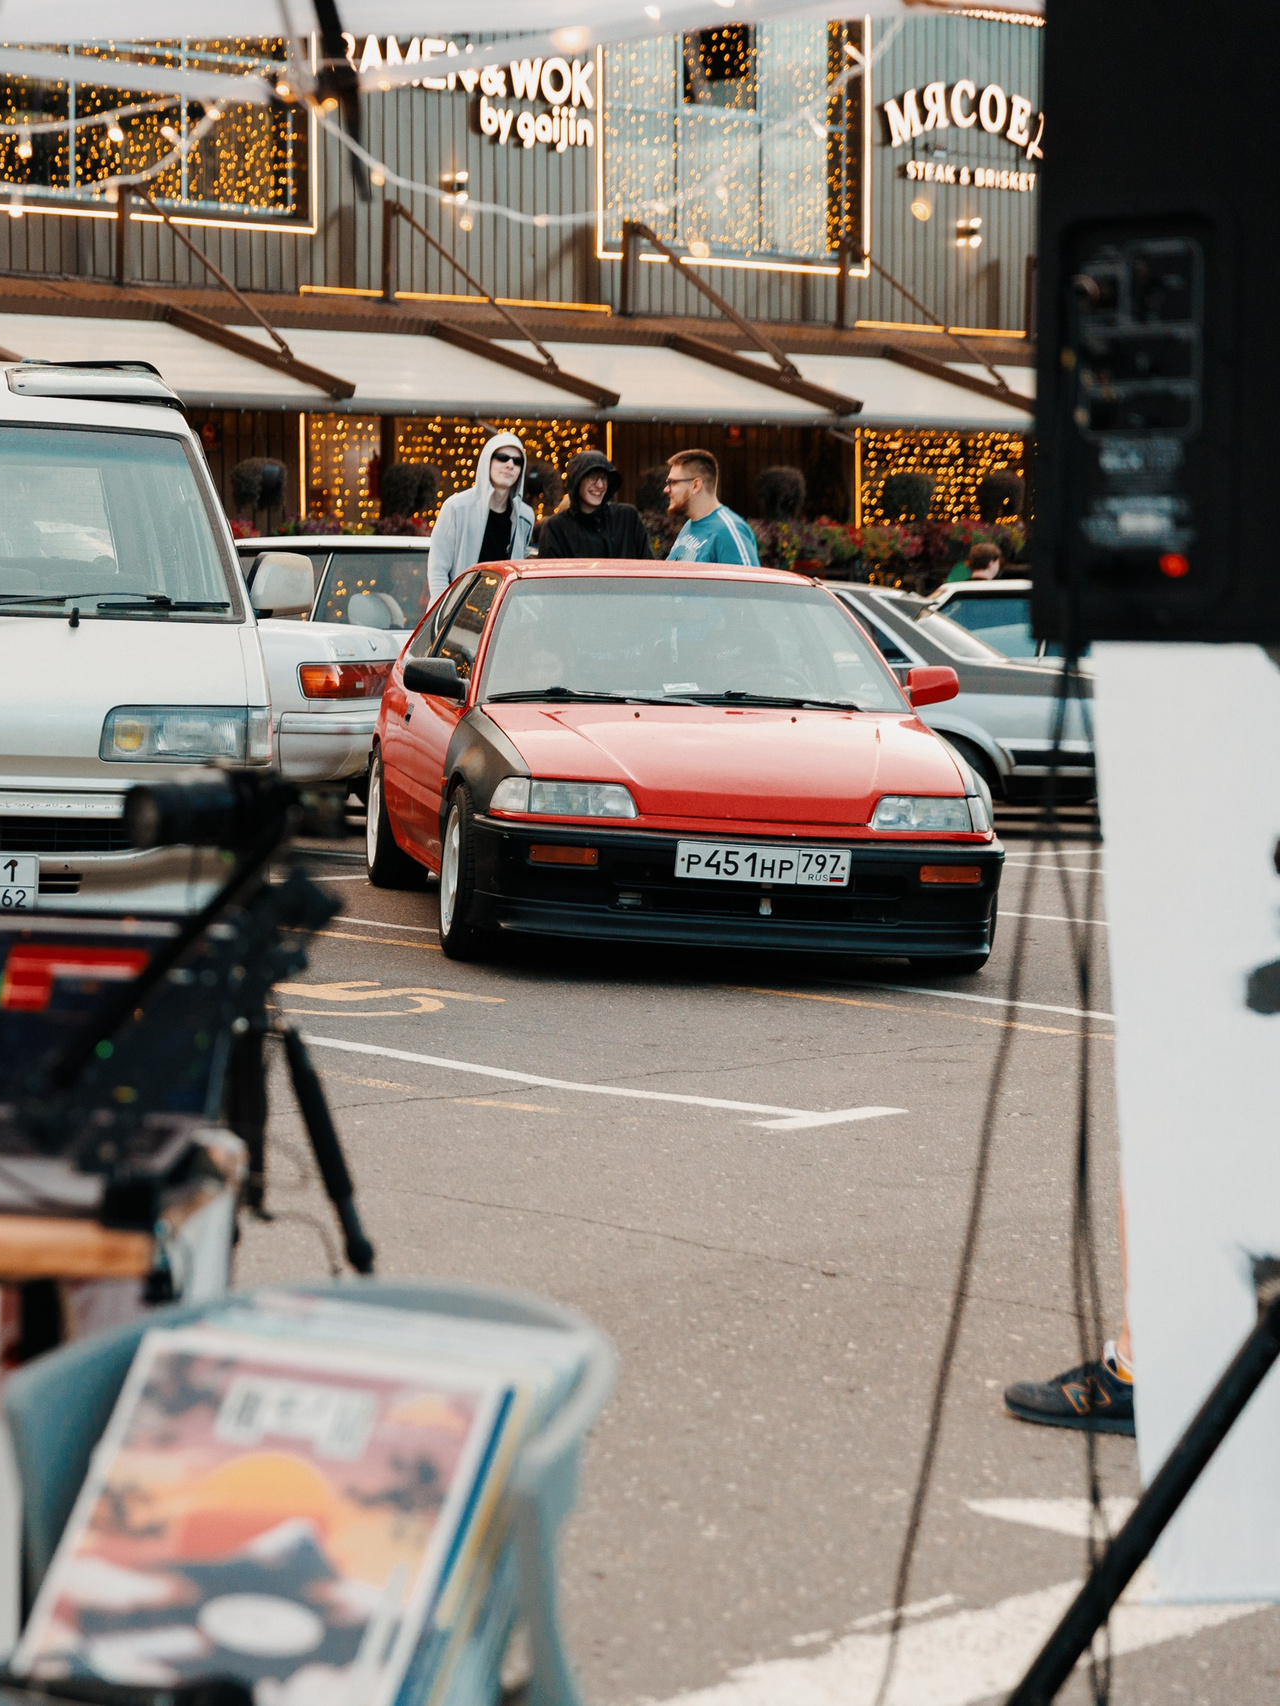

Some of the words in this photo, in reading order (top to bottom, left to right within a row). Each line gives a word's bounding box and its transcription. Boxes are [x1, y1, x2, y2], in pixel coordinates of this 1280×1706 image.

[510, 57, 595, 109] WOK
[480, 96, 514, 146] by
[517, 105, 595, 153] gaijin
[906, 160, 956, 185] STEAK
[959, 165, 971, 186] &
[974, 167, 1036, 192] BRISKET
[686, 849, 794, 880] Р451НР
[801, 853, 841, 874] 797
[807, 873, 829, 882] RUS
[1, 889, 26, 908] 62
